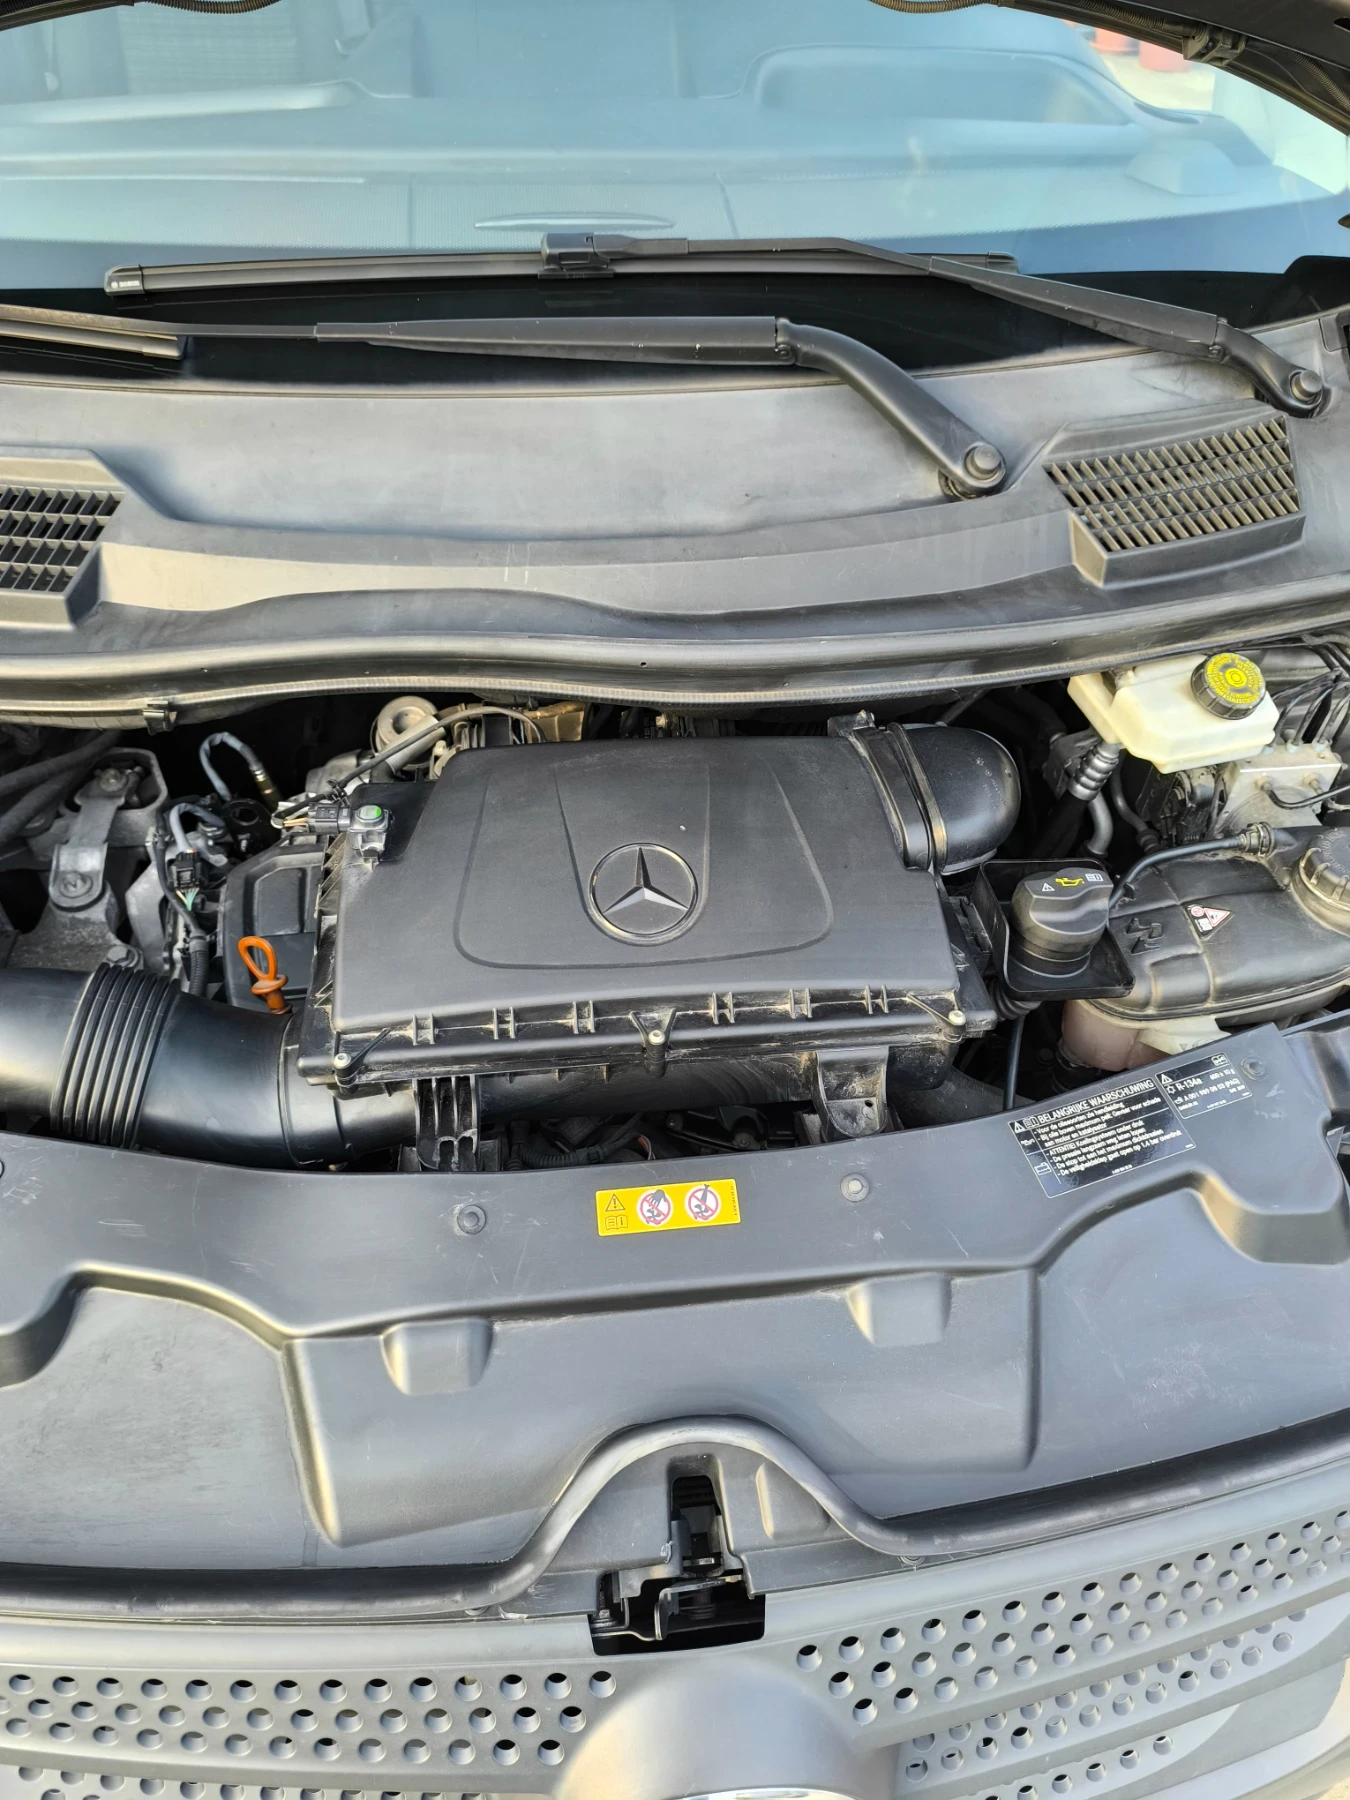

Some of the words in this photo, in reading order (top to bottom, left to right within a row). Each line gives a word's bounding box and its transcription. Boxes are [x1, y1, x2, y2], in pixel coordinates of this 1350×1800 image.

[1176, 1078, 1203, 1090] R-134a
[1038, 1101, 1089, 1123] BELANGRIJKE
[1089, 1080, 1153, 1106] WAARSCHUWING
[1058, 1126, 1075, 1134] boven
[1142, 1097, 1161, 1106] schade
[1036, 1126, 1049, 1134] Voor
[1116, 1125, 1131, 1133] onder
[1132, 1120, 1144, 1128] druk
[1054, 1135, 1070, 1143] motor
